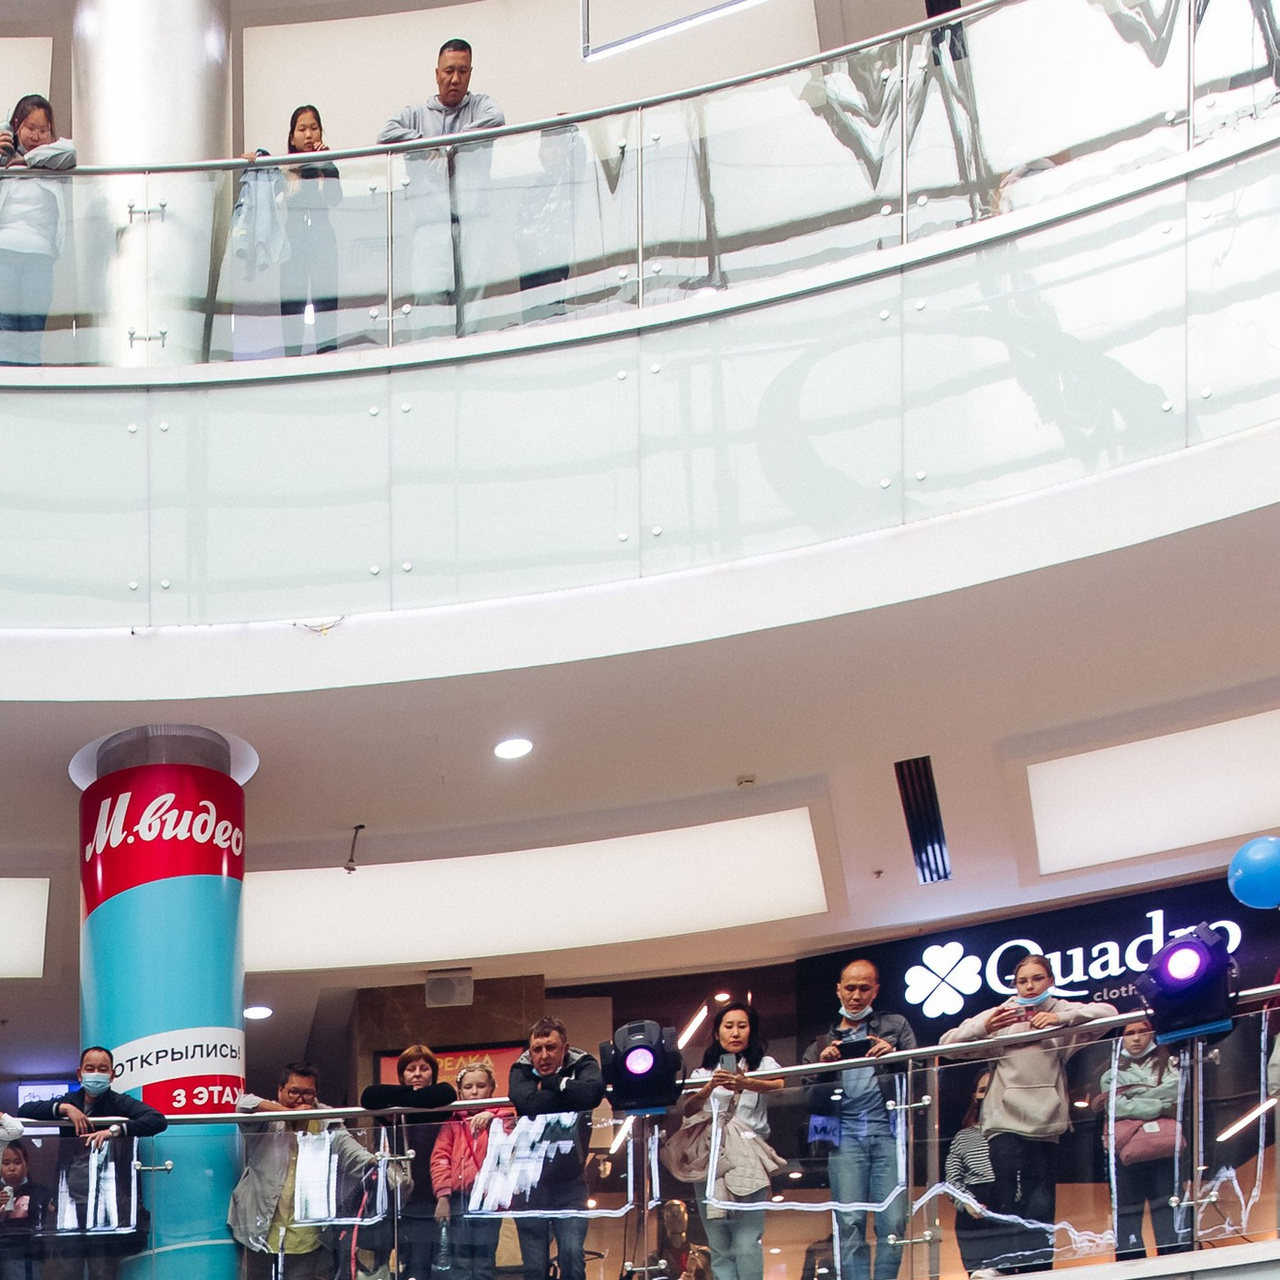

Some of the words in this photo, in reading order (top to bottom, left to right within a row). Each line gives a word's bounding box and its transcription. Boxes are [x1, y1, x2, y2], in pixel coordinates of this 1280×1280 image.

[85, 791, 244, 862] М.видео
[985, 909, 1242, 998] Quado
[114, 1043, 241, 1078] ОТКРЫЛИСЬ!
[172, 1089, 187, 1108] 3
